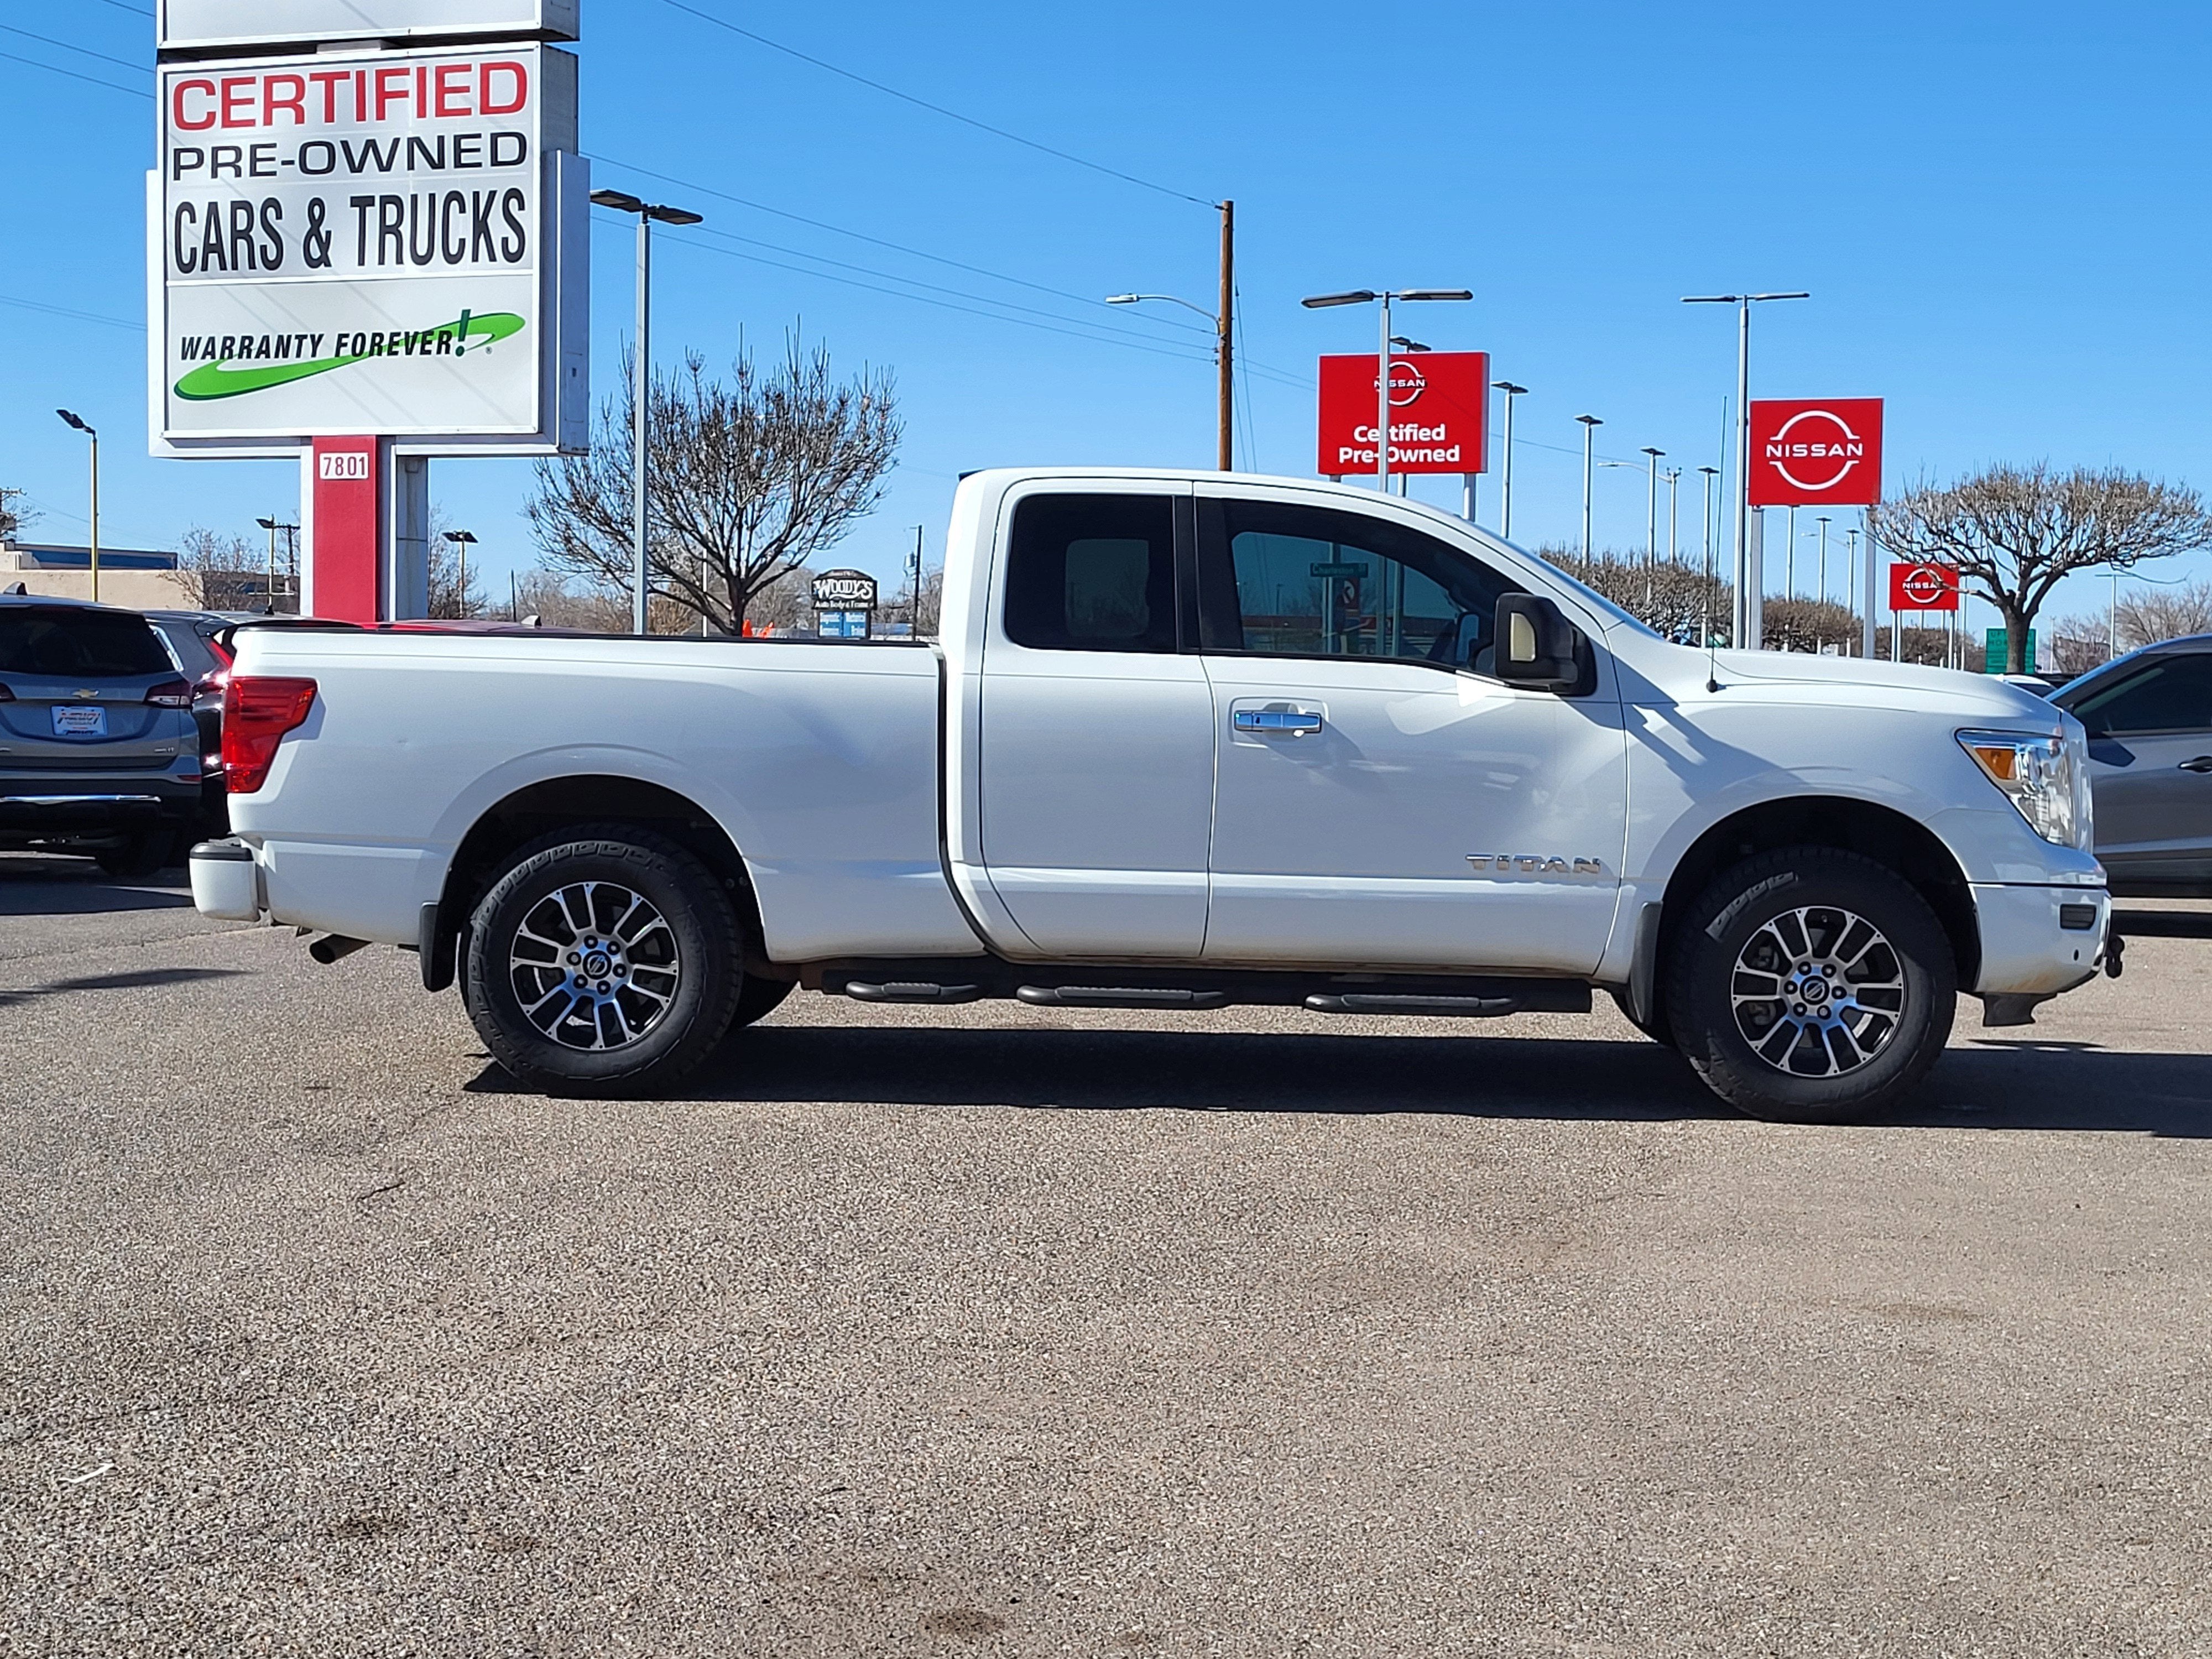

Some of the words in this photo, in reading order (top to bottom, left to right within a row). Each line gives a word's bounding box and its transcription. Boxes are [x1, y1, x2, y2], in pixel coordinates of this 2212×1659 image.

[173, 61, 527, 131] CERTIFIED
[173, 132, 527, 181] PRE-OWNED
[174, 197, 284, 274] CARS
[303, 197, 332, 269] &
[349, 188, 526, 267] TRUCKS
[181, 333, 325, 361] WARRANTY
[334, 309, 472, 358] FOREVER!
[1374, 379, 1425, 388] NSSAN
[1354, 424, 1446, 442] Cetified
[1766, 443, 1863, 457] NISSAN
[323, 456, 366, 476] 7801
[813, 578, 873, 599] WOODY'S
[1465, 854, 1600, 874] TITAN
